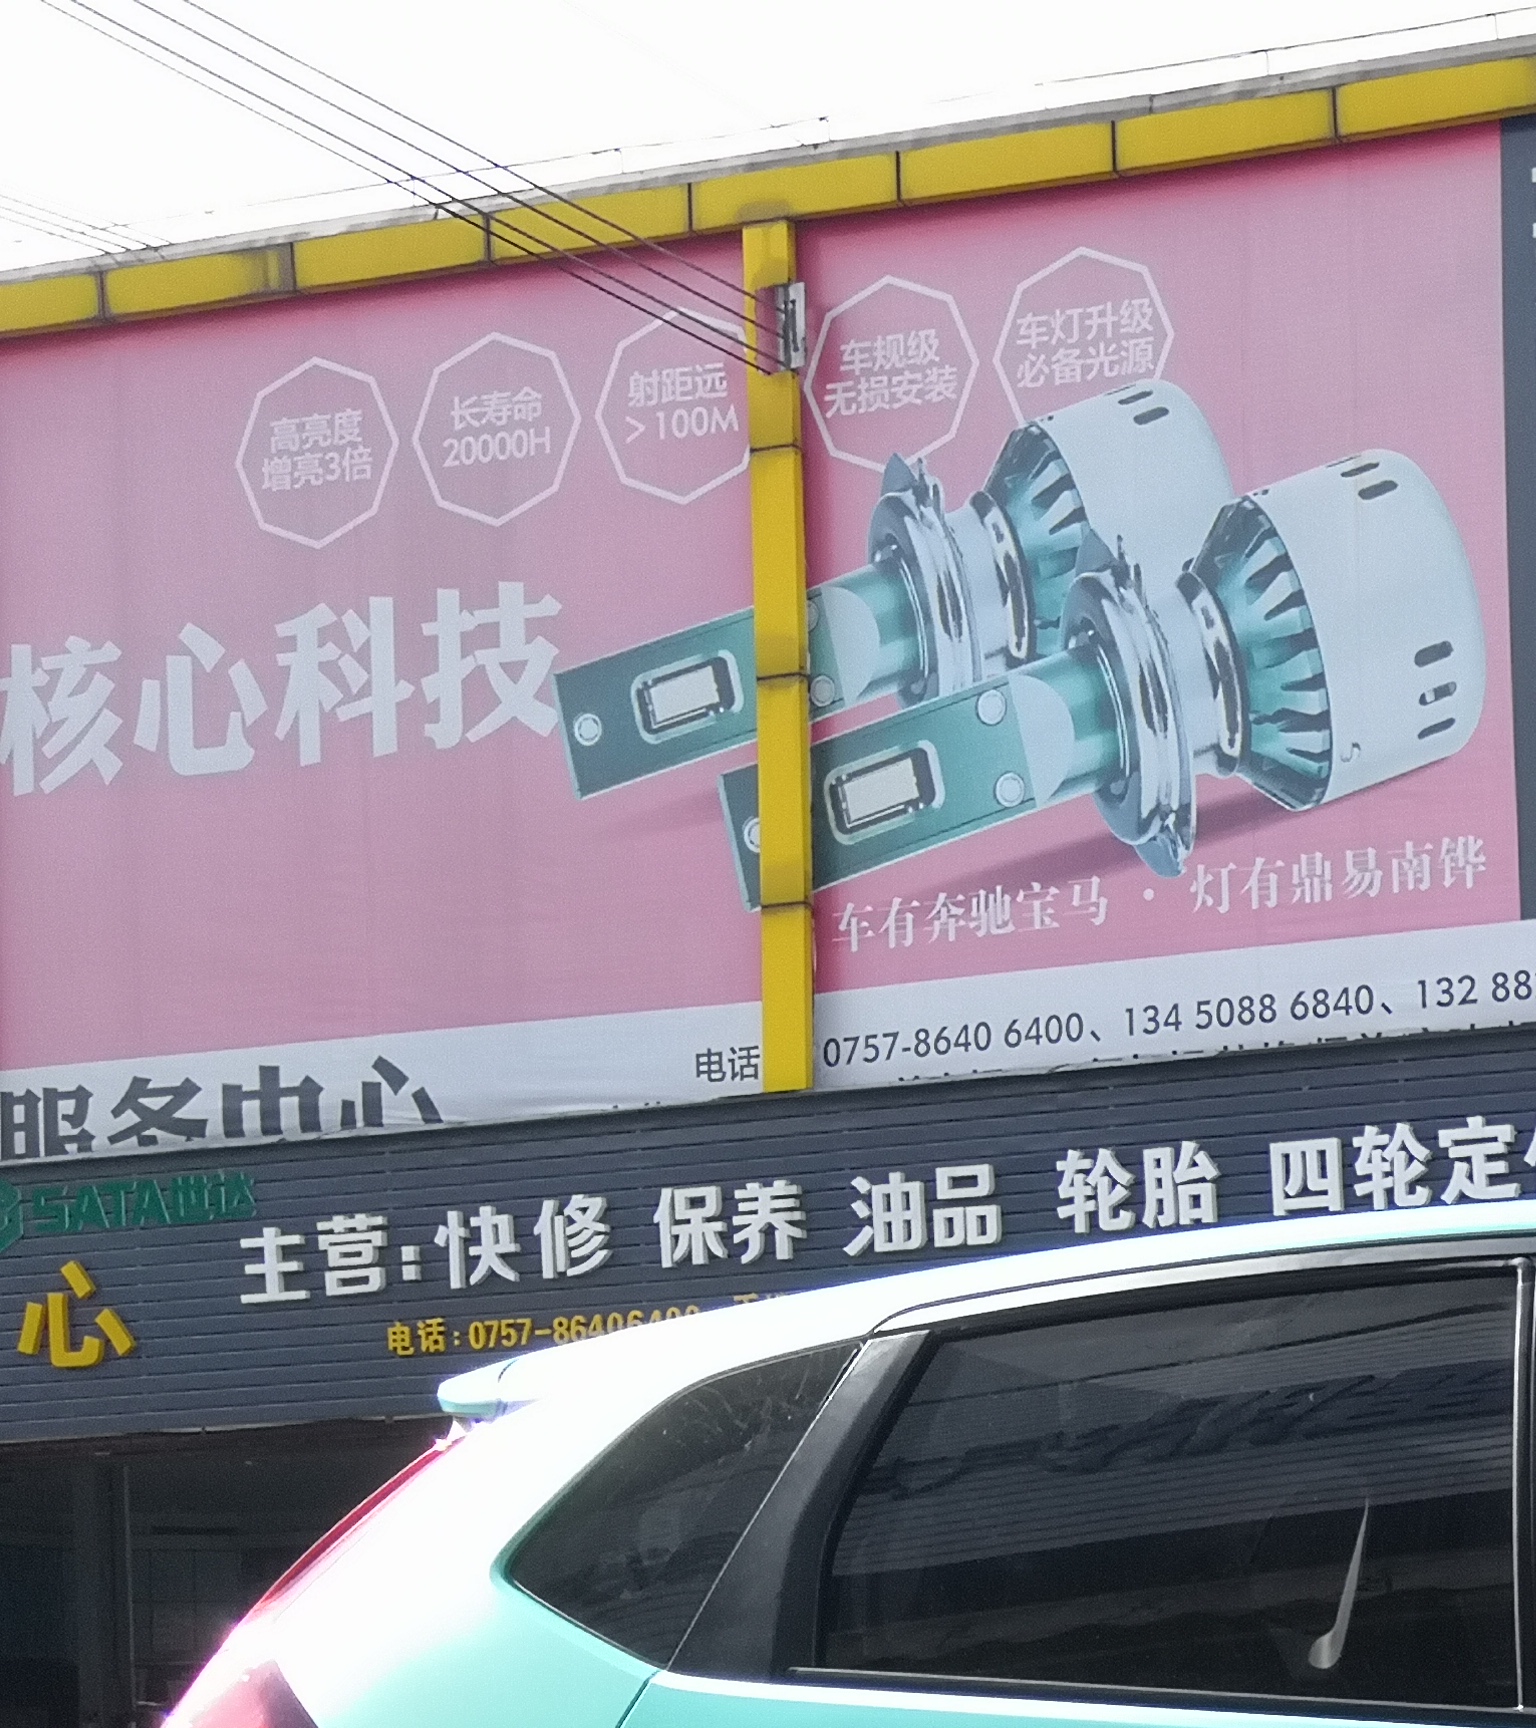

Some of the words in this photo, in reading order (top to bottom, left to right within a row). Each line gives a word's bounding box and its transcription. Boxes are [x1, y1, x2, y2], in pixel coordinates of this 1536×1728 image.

[1015, 297, 1155, 350] 车灯升级
[839, 328, 940, 376] 车规级
[1016, 335, 1155, 390] 必备光源
[450, 386, 543, 431] 长寿命
[628, 362, 728, 407] 射距远
[824, 365, 958, 419] 无损安装
[269, 408, 363, 454] 高亮度
[442, 426, 552, 468] 20000H
[261, 445, 373, 492] 增亮3倍
[0, 581, 563, 796] 核心科技
[832, 875, 1109, 953] 车有奔驰宝马
[695, 1045, 759, 1083] 电话
[822, 1021, 992, 1067] 0757-8640
[1195, 992, 1278, 1030] 5088
[653, 1179, 807, 1269] 保养
[843, 1163, 1003, 1258] 油品
[1055, 1140, 1219, 1234] 轮胎
